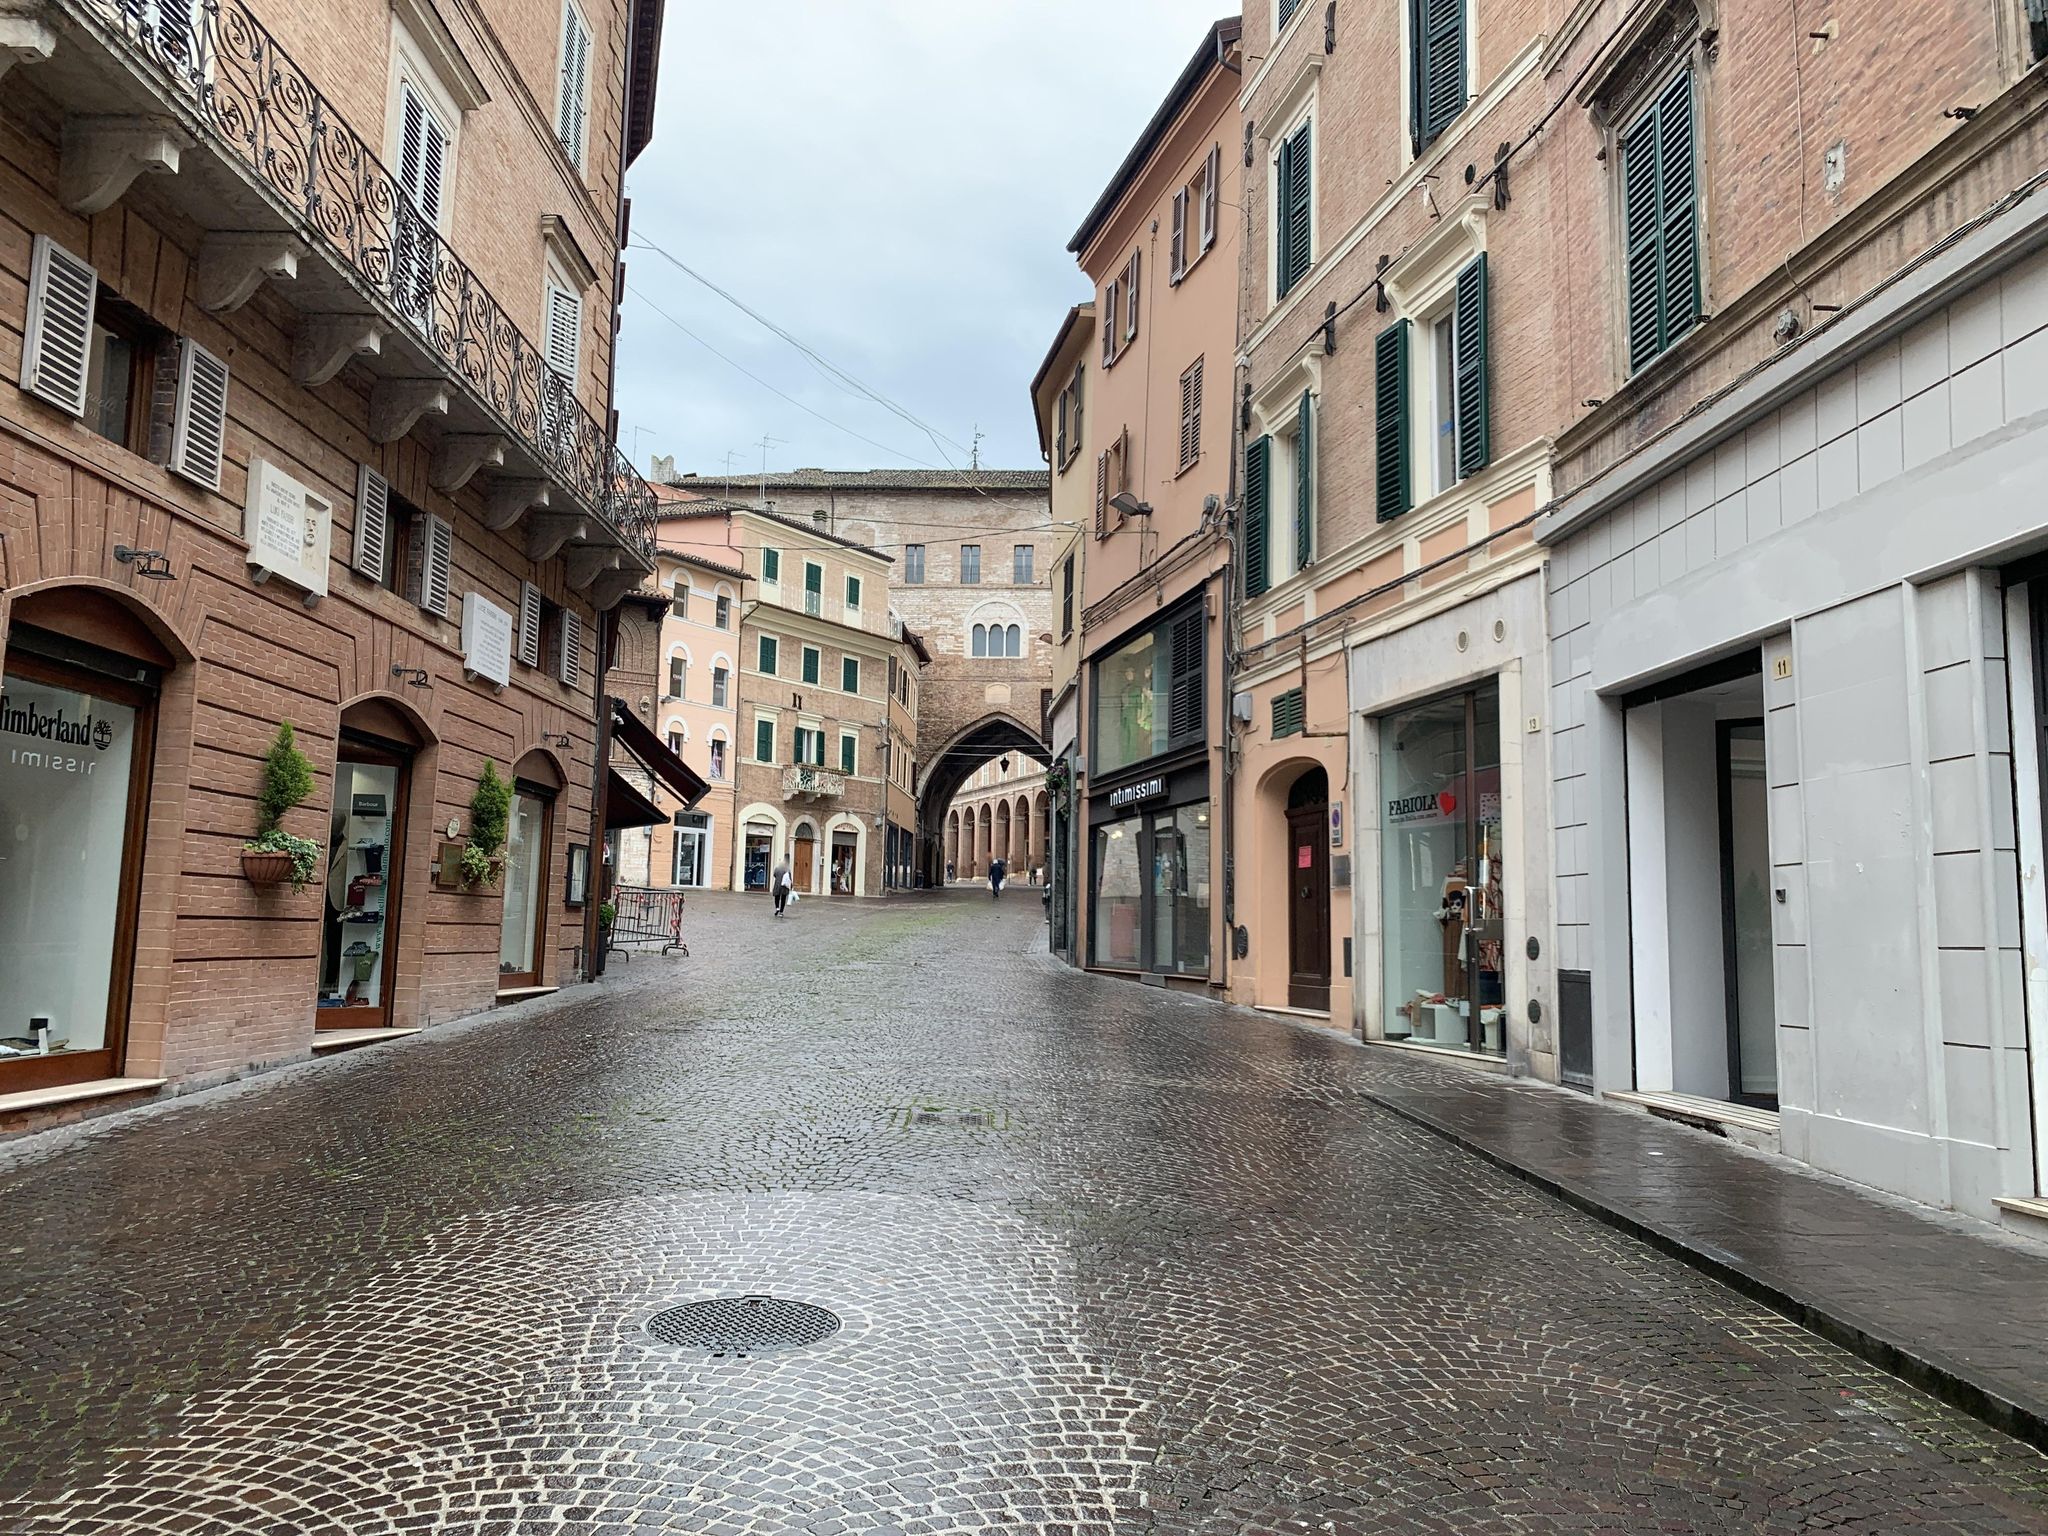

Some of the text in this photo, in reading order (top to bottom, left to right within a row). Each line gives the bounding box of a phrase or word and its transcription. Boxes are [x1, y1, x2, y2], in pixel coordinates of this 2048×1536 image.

[1777, 659, 1787, 676] 11
[1528, 717, 1537, 730] 13
[1109, 778, 1162, 807] intimissimi
